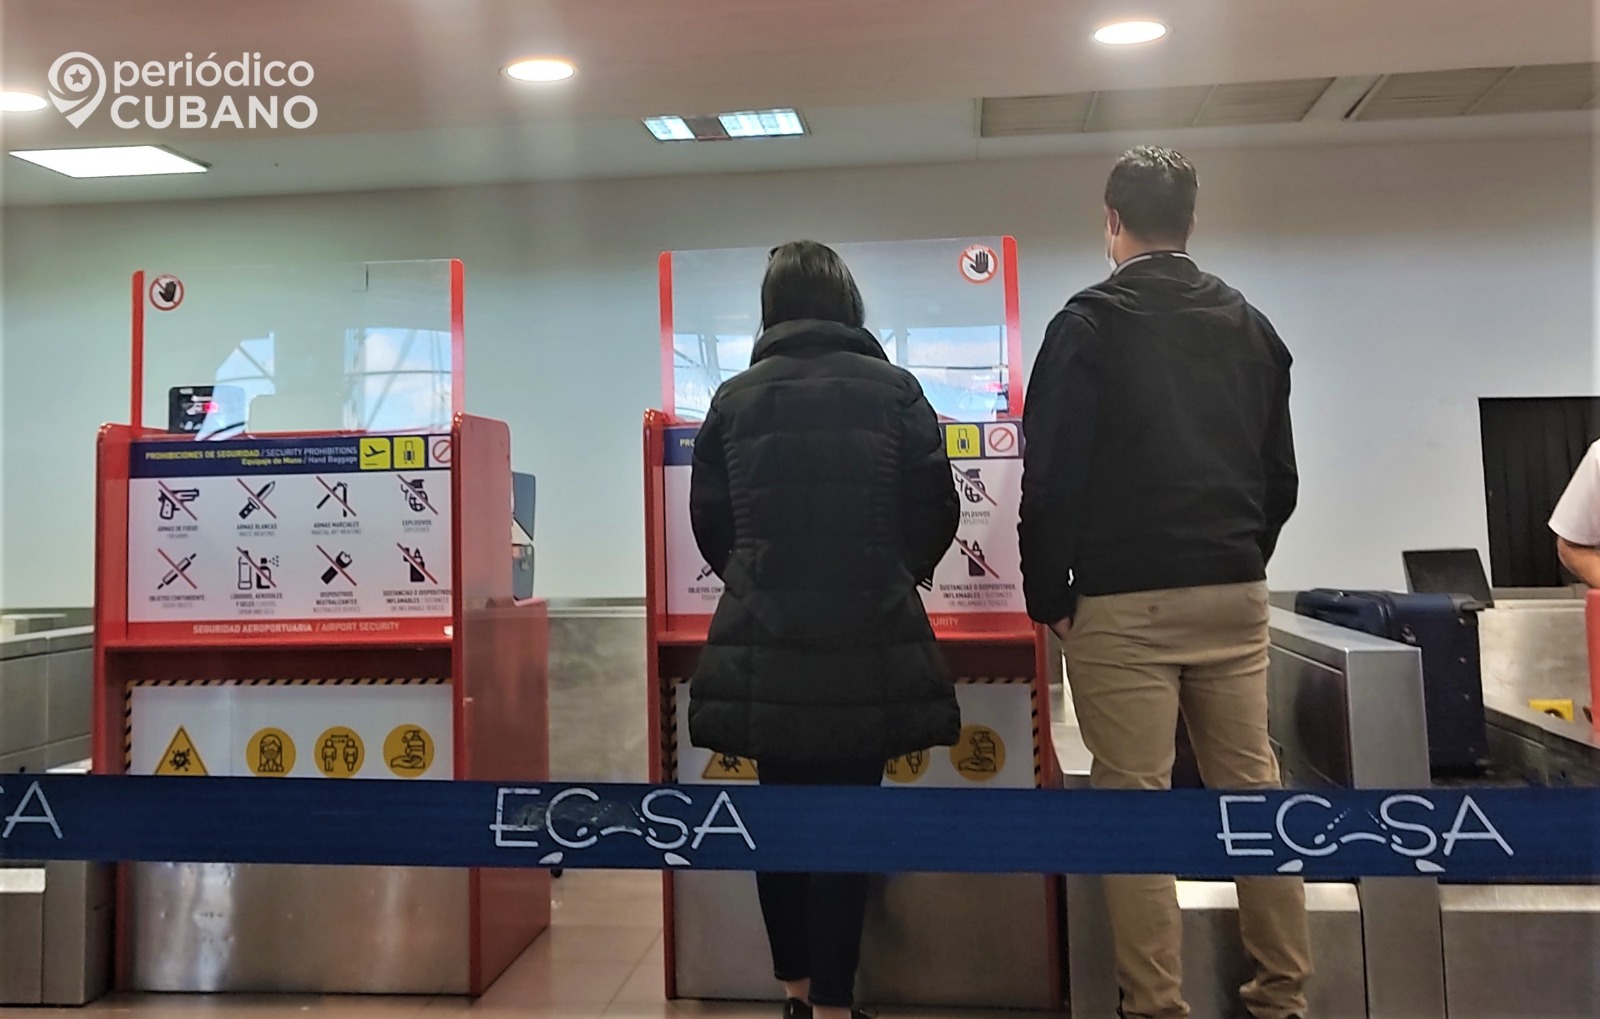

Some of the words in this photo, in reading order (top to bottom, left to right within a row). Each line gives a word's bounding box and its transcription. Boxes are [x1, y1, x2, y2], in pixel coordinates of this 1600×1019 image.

[265, 447, 302, 457] SECURITY
[303, 446, 358, 455] PROHIBITIONS
[193, 624, 240, 634] SEGURIDAD
[241, 623, 313, 633] AEROPORTUARIA
[320, 622, 357, 632] AIRPORT
[358, 621, 400, 632] SECURITY
